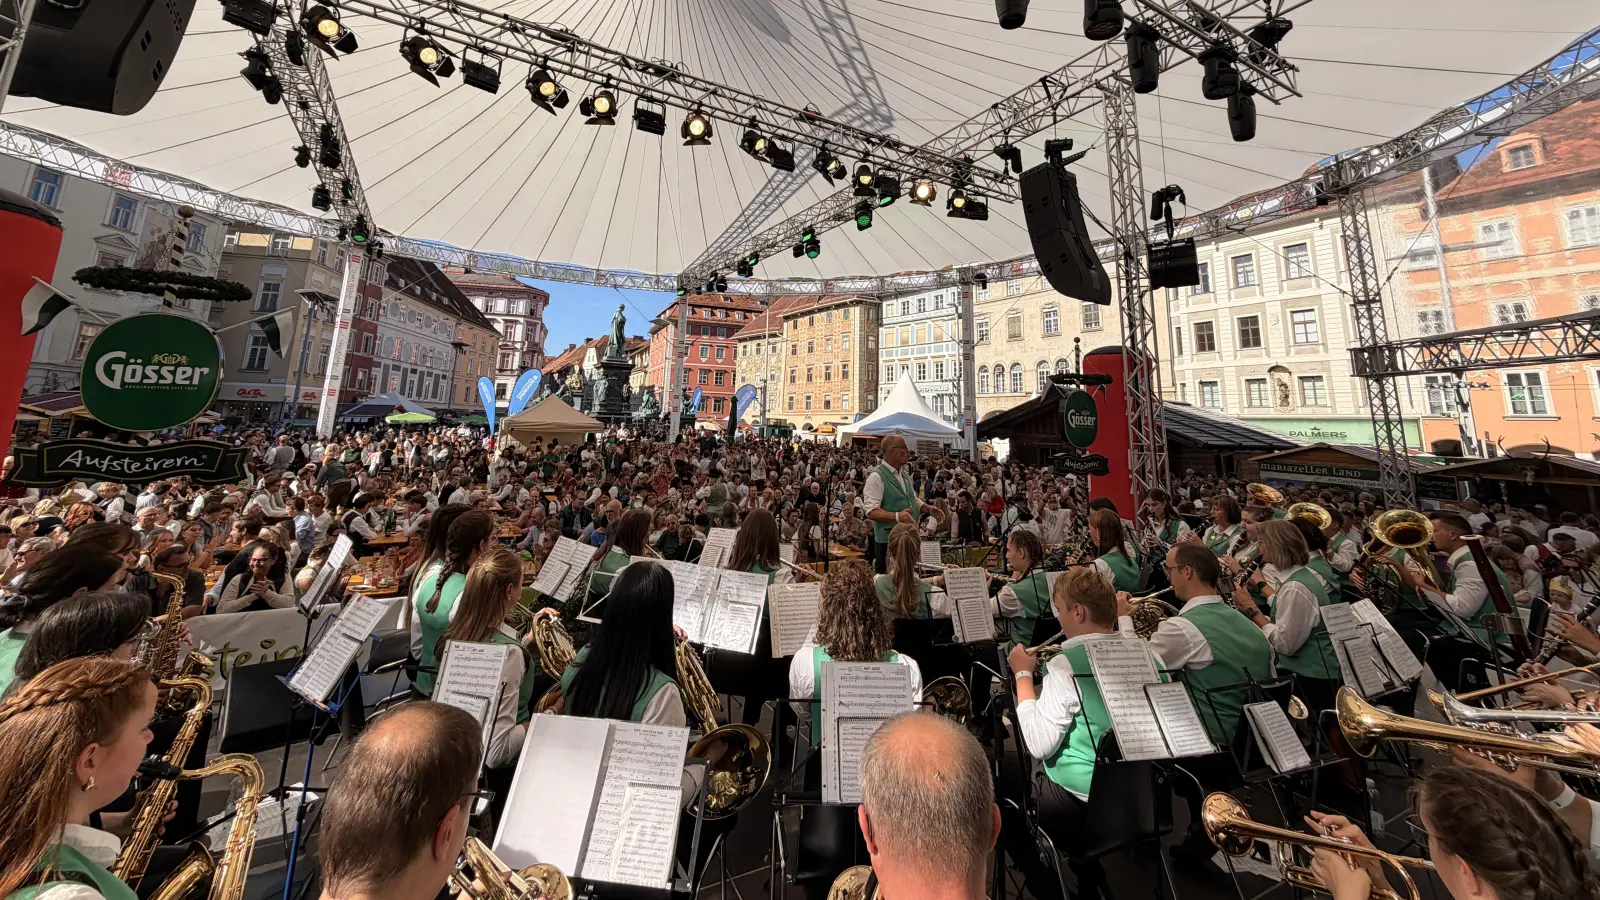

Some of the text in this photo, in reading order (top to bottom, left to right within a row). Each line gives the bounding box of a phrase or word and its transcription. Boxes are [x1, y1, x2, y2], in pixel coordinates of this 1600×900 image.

[95, 351, 209, 389] Gösser
[1068, 409, 1096, 428] Gösser
[58, 449, 202, 474] Aufsteirern
